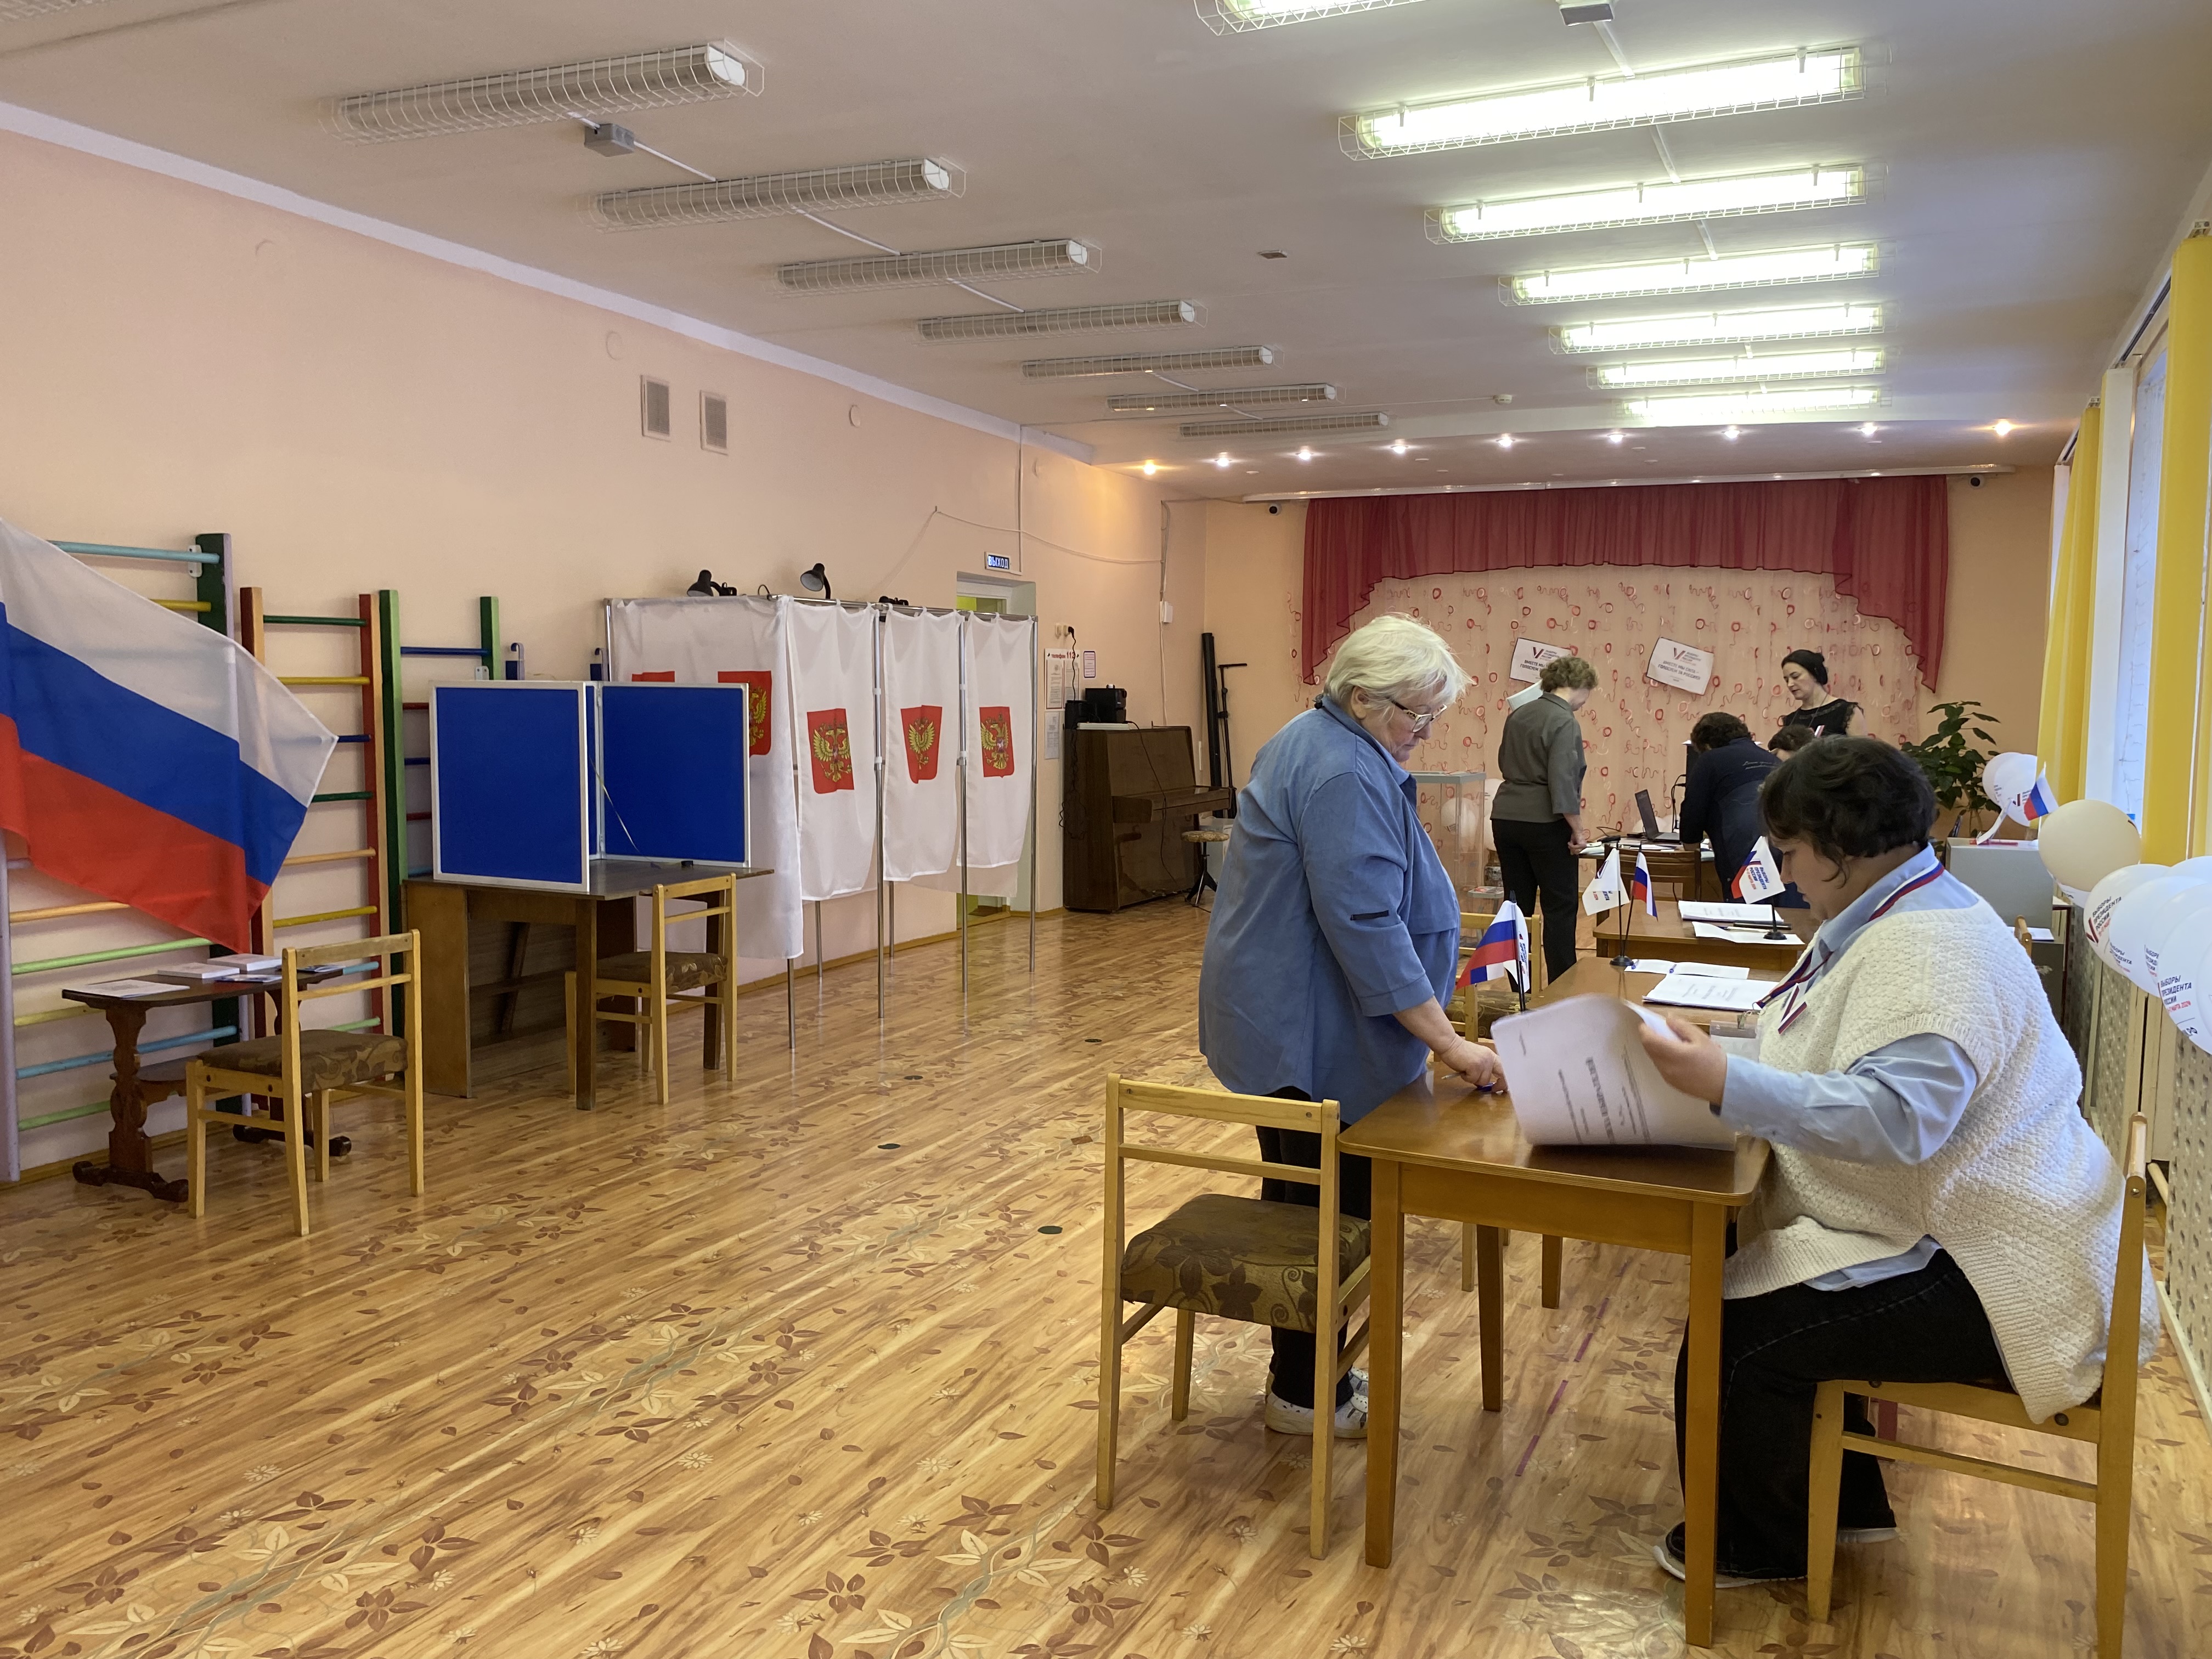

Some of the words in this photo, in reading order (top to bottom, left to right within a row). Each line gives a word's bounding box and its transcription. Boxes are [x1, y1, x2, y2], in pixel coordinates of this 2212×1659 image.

[988, 555, 1009, 569] ВЫХОД
[1658, 664, 1678, 673] ГОЛОСУЕМ
[1750, 867, 1758, 881] РОССИИ
[1754, 867, 1767, 889] ПРЕЗИДЕНТА
[1759, 867, 1769, 883] ВЫБОРЫ
[2092, 896, 2112, 918] ВЫБОРЫ
[2094, 896, 2122, 925] ПРЕЗИДЕНТА
[2096, 912, 2110, 932] РОССИИ
[2160, 975, 2181, 988] ВЫБОРЫ
